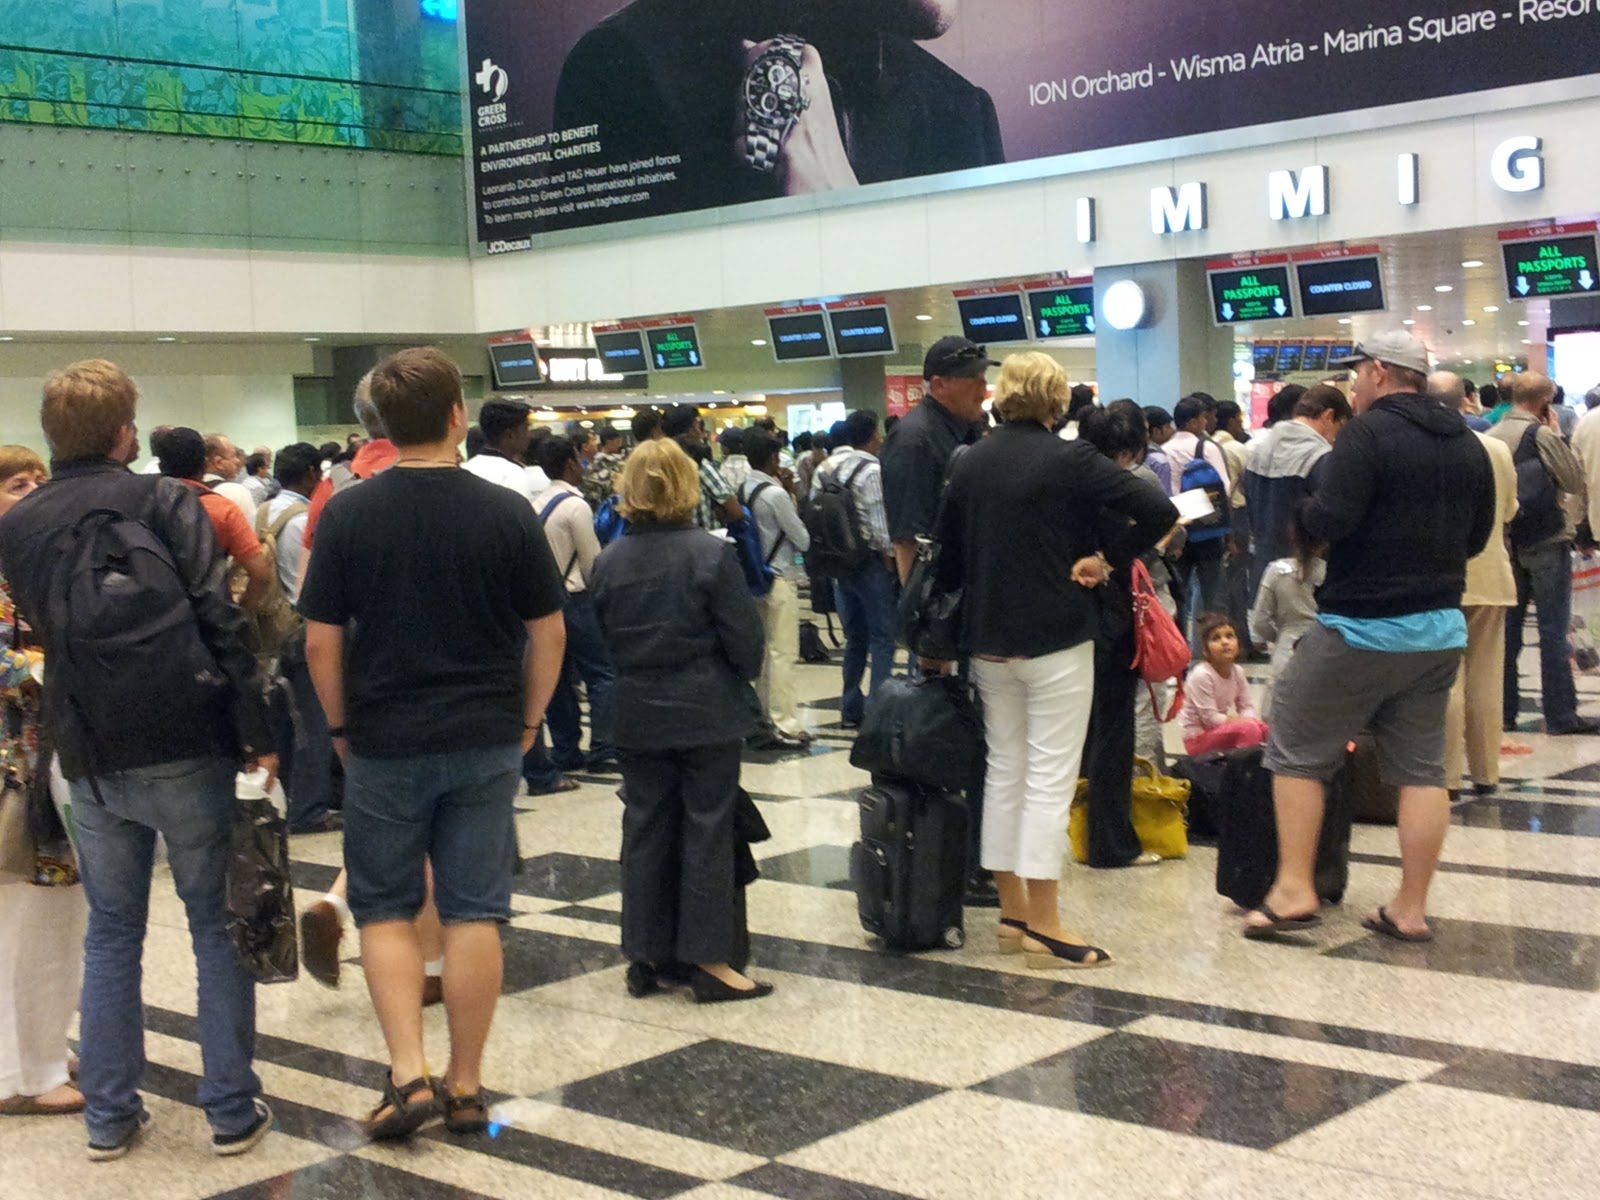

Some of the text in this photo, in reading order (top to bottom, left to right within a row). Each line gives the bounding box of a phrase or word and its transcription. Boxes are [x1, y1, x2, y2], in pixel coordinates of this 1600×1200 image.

[1029, 78, 1067, 106] ION
[1071, 62, 1153, 99] Orchard
[1170, 52, 1246, 82] Wisma
[1250, 38, 1304, 69] Atria
[1324, 23, 1402, 57] Marina
[1408, 9, 1496, 43] Square
[478, 102, 507, 117] GREEN
[478, 113, 508, 127] CROSS
[480, 123, 599, 157] A PARTNERSHIP TO BENEFIT
[480, 140, 602, 173] ENVIRONMENTAL CHARITIES
[482, 182, 517, 196] Leonardo
[517, 177, 550, 191] DiCaprio
[550, 172, 566, 185] and
[584, 166, 608, 178] Heuer
[608, 162, 629, 175] have
[629, 156, 655, 173] joined
[655, 153, 681, 167] forces
[482, 200, 492, 210] to
[492, 195, 530, 209] contribute
[530, 193, 540, 204] to
[540, 188, 564, 202] Green
[564, 185, 586, 198] Cross
[586, 175, 636, 193] International
[484, 191, 650, 224] To learn more please visit www.tagheuer.com
[487, 239, 531, 254] JCDecaux
[1539, 245, 1562, 258] ALL
[1518, 256, 1586, 274] PASSPORTS
[1240, 275, 1260, 287] ALL
[1309, 280, 1372, 294] COUNTER CLOSED
[1055, 295, 1072, 305] ALL
[1223, 285, 1280, 300] PASSPORTS
[1040, 303, 1091, 318] PASSPORTS
[969, 314, 1018, 326] COUNTER CLOSED
[666, 332, 679, 341] ALL
[656, 340, 693, 351] PASSPORTS
